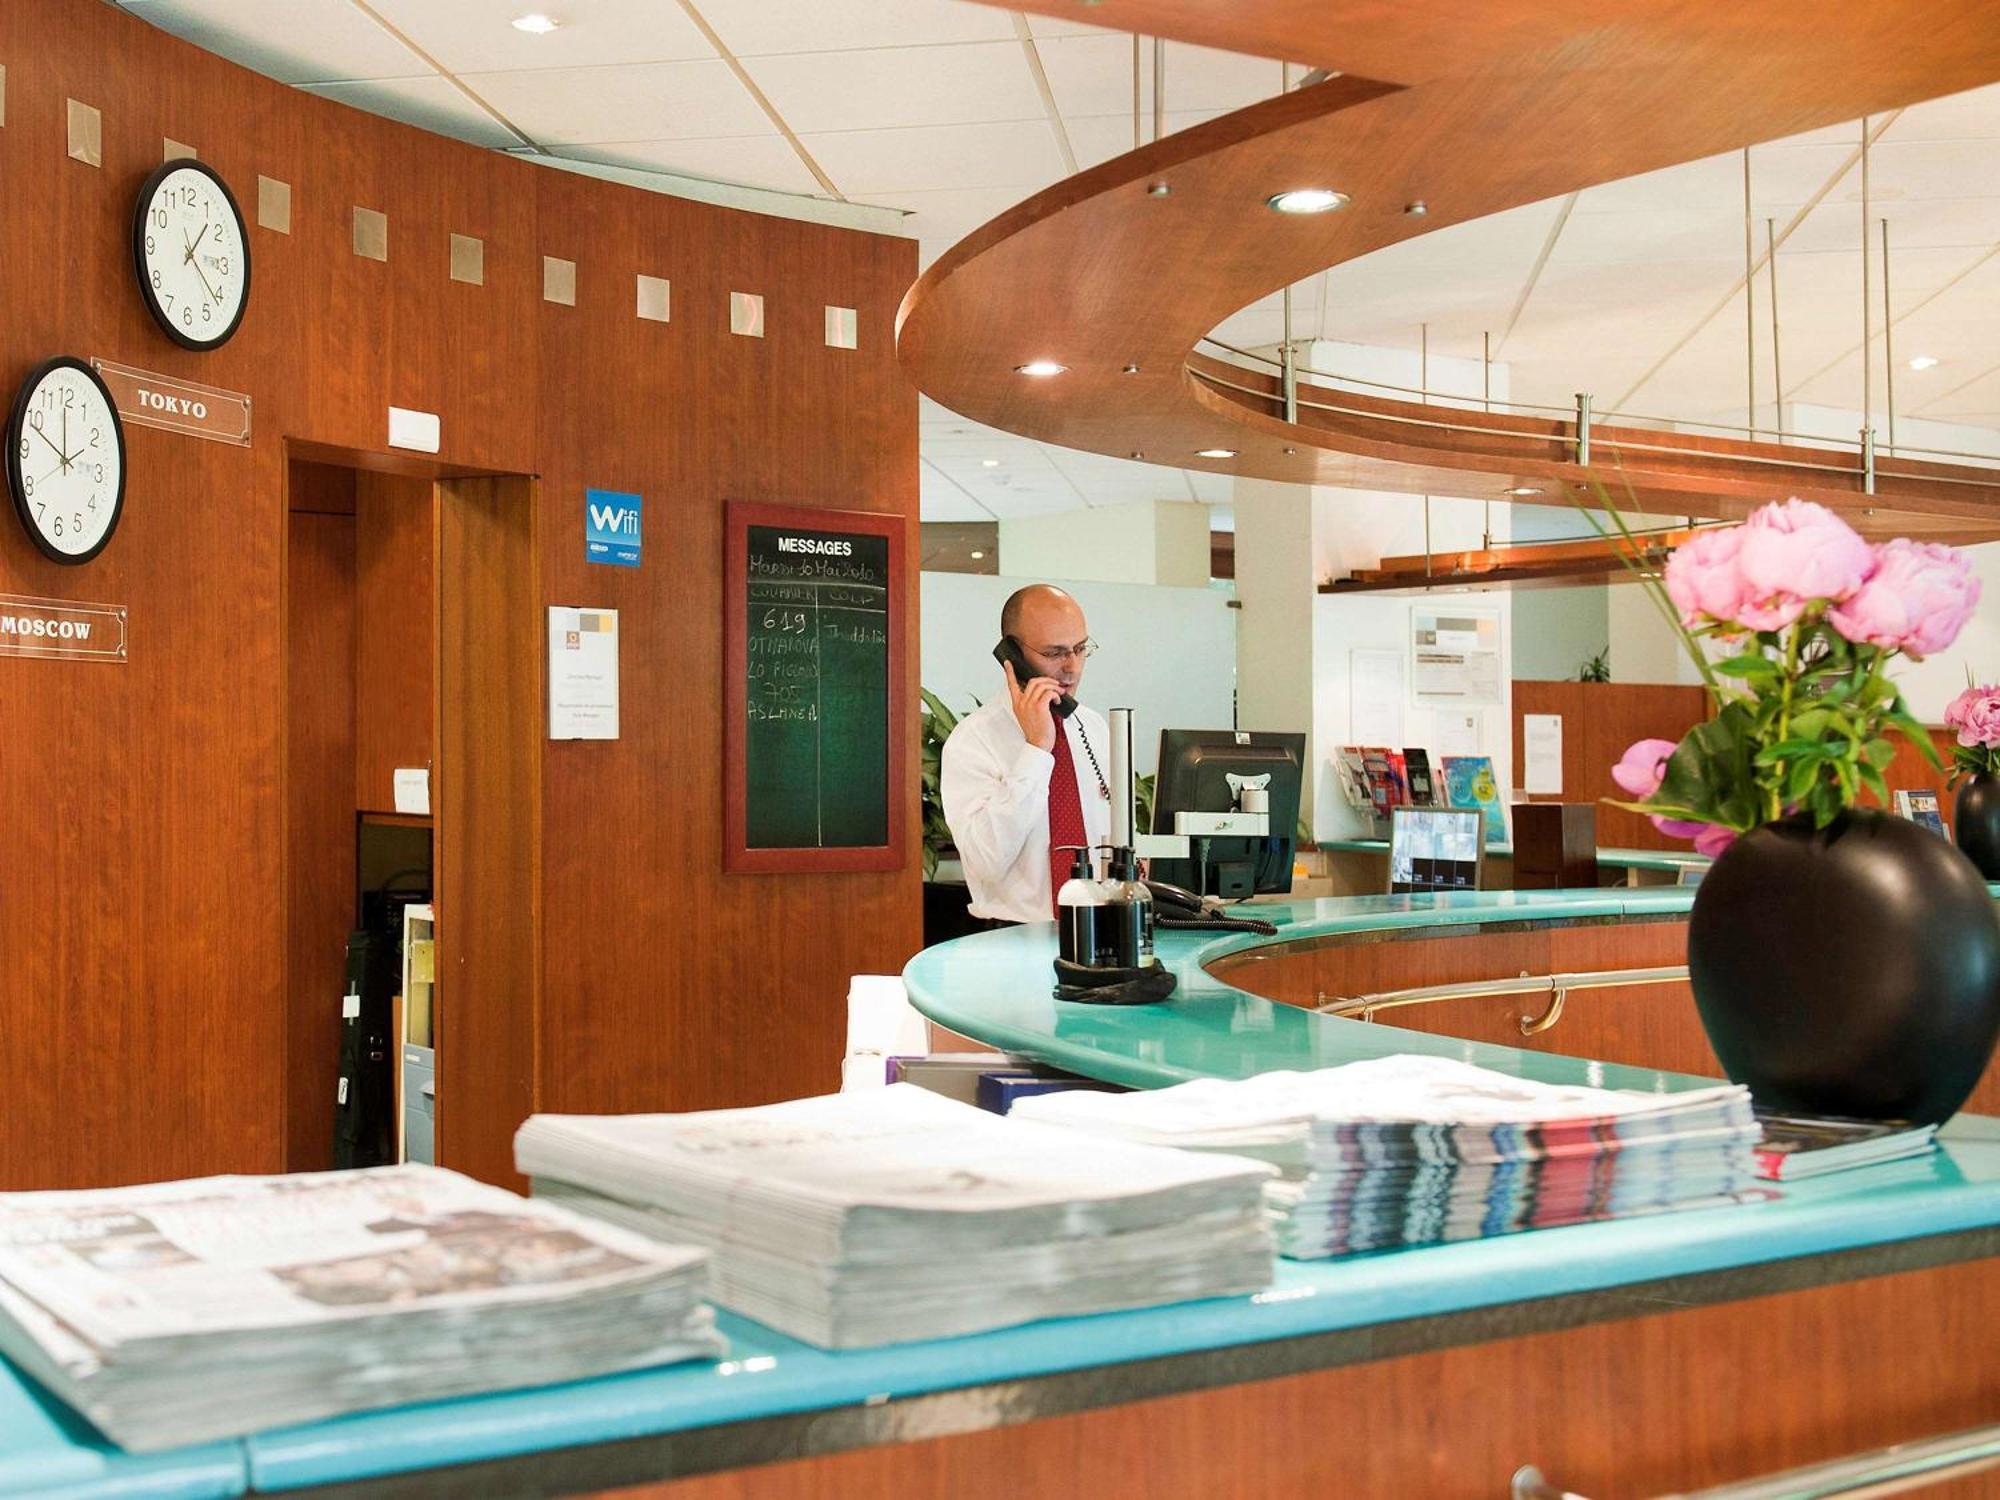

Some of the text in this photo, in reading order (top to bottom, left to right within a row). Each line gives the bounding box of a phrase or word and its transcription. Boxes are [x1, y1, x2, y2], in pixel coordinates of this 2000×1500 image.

[163, 189, 176, 209] 11
[180, 184, 197, 208] 12
[151, 207, 168, 229] 10
[204, 200, 209, 219] 1
[214, 223, 224, 243] 2
[146, 235, 156, 256] 9
[219, 256, 229, 276] 3
[152, 269, 161, 289] 8
[165, 294, 175, 313] 7
[202, 303, 212, 322] 5
[183, 306, 193, 326] 6
[41, 387, 53, 410] 11
[58, 386, 74, 409] 12
[137, 389, 207, 419] TOKYO
[27, 407, 44, 432] 10
[81, 402, 87, 422] 1
[90, 427, 100, 448] 2
[20, 438, 29, 459] 9
[94, 463, 103, 484] 3
[24, 475, 34, 496] 8
[37, 501, 46, 523] 7
[87, 493, 97, 513] 4
[54, 516, 63, 537] 6
[72, 512, 82, 533] 5
[589, 503, 639, 535] Wifi
[777, 536, 852, 557] MESSAGES
[1, 615, 91, 640] MOSCOW
[763, 608, 807, 635] 619
